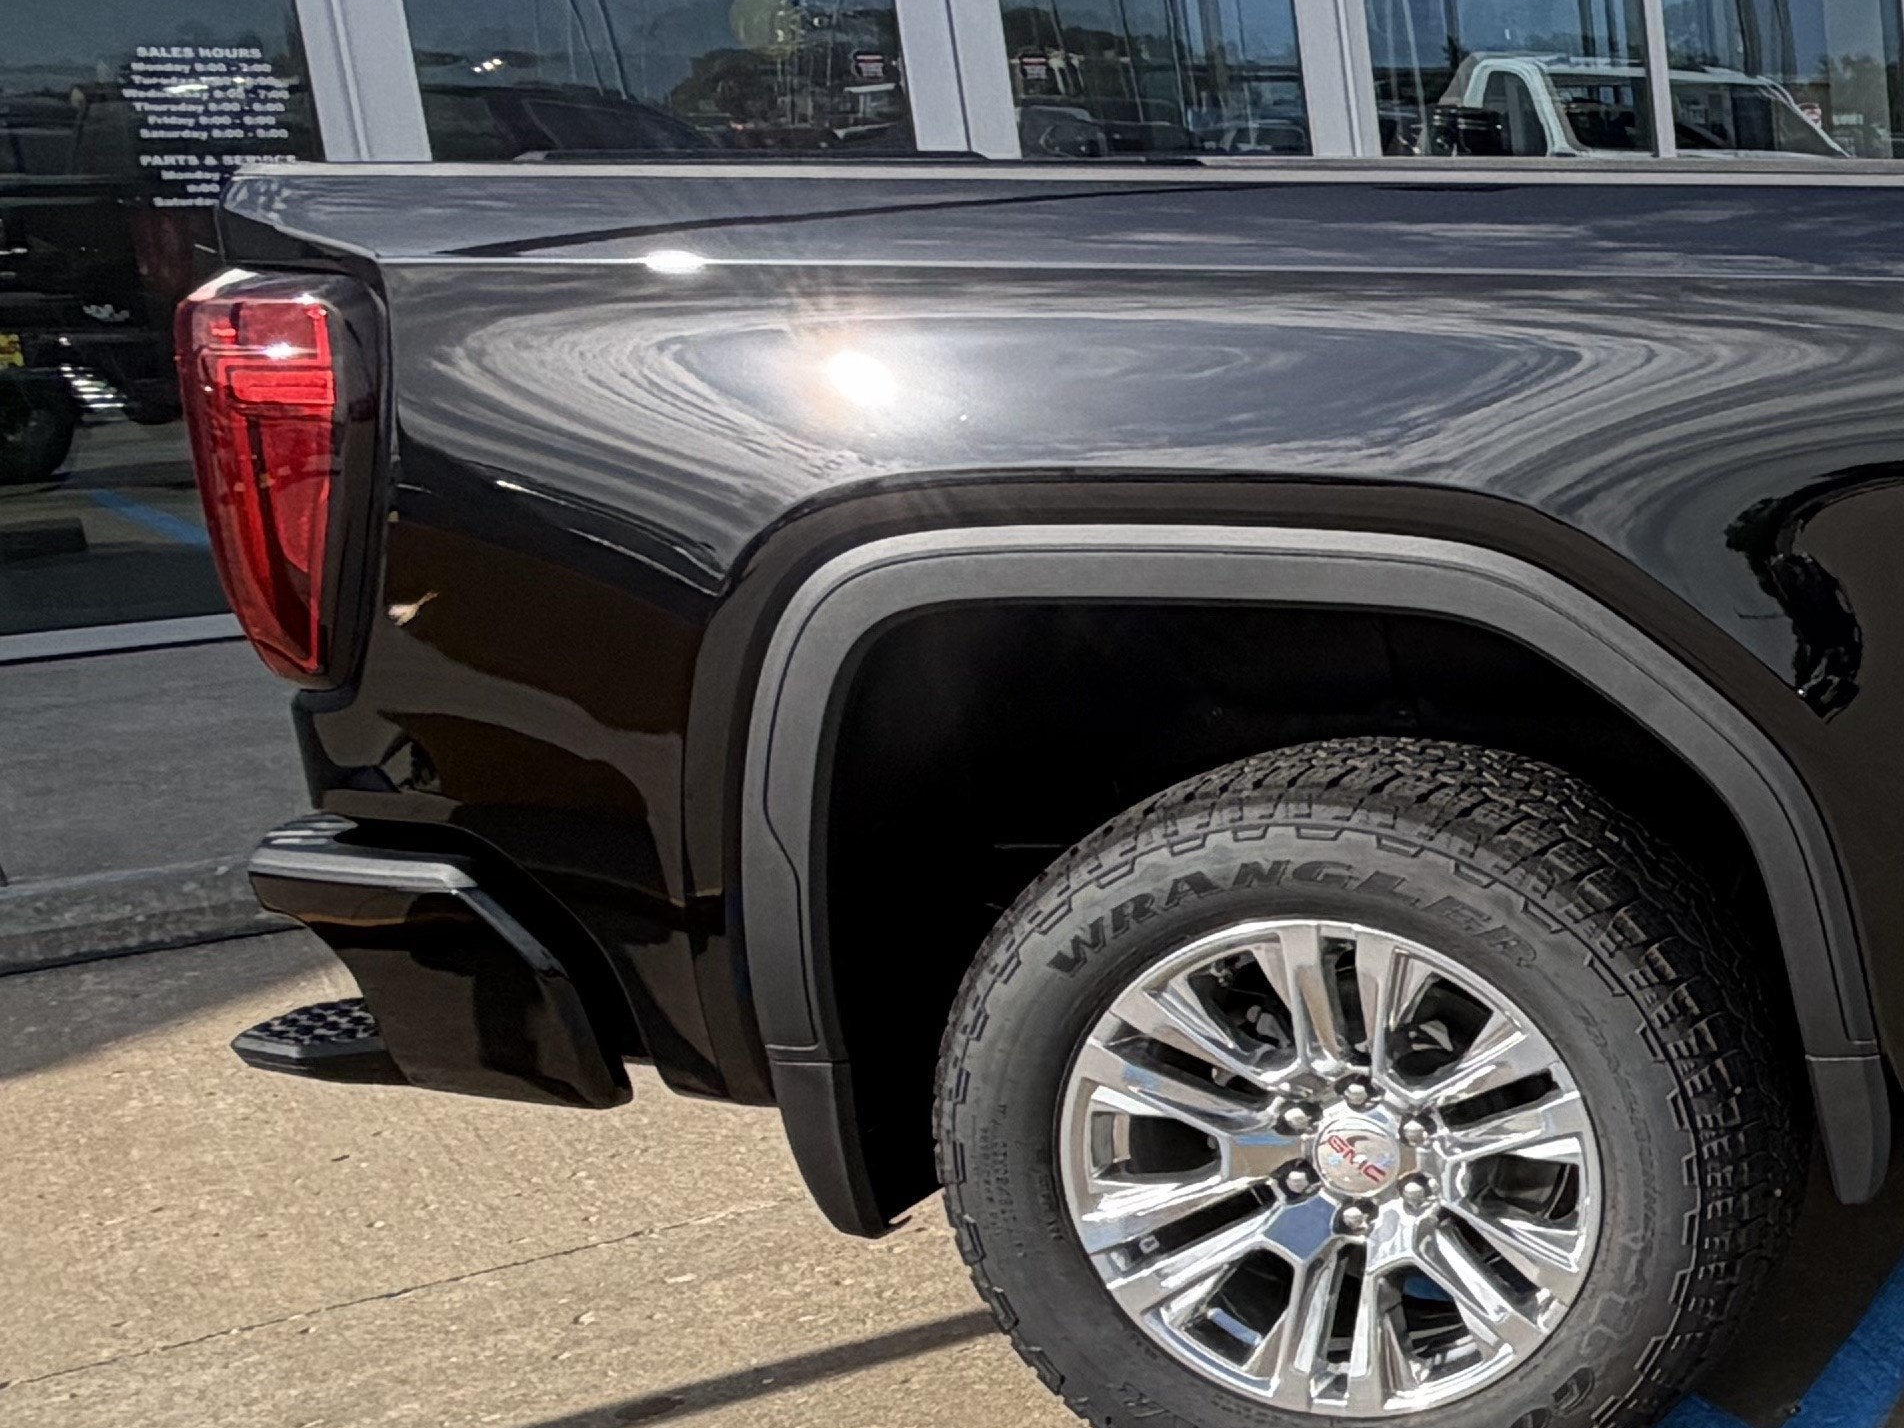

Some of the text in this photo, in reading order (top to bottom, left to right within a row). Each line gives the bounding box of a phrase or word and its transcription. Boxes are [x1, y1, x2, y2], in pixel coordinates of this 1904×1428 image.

[136, 46, 262, 59] SALES HOURS
[139, 155, 199, 166] PARTS
[1046, 859, 1538, 974] WRANGLER
[1327, 1134, 1387, 1184] GMC
